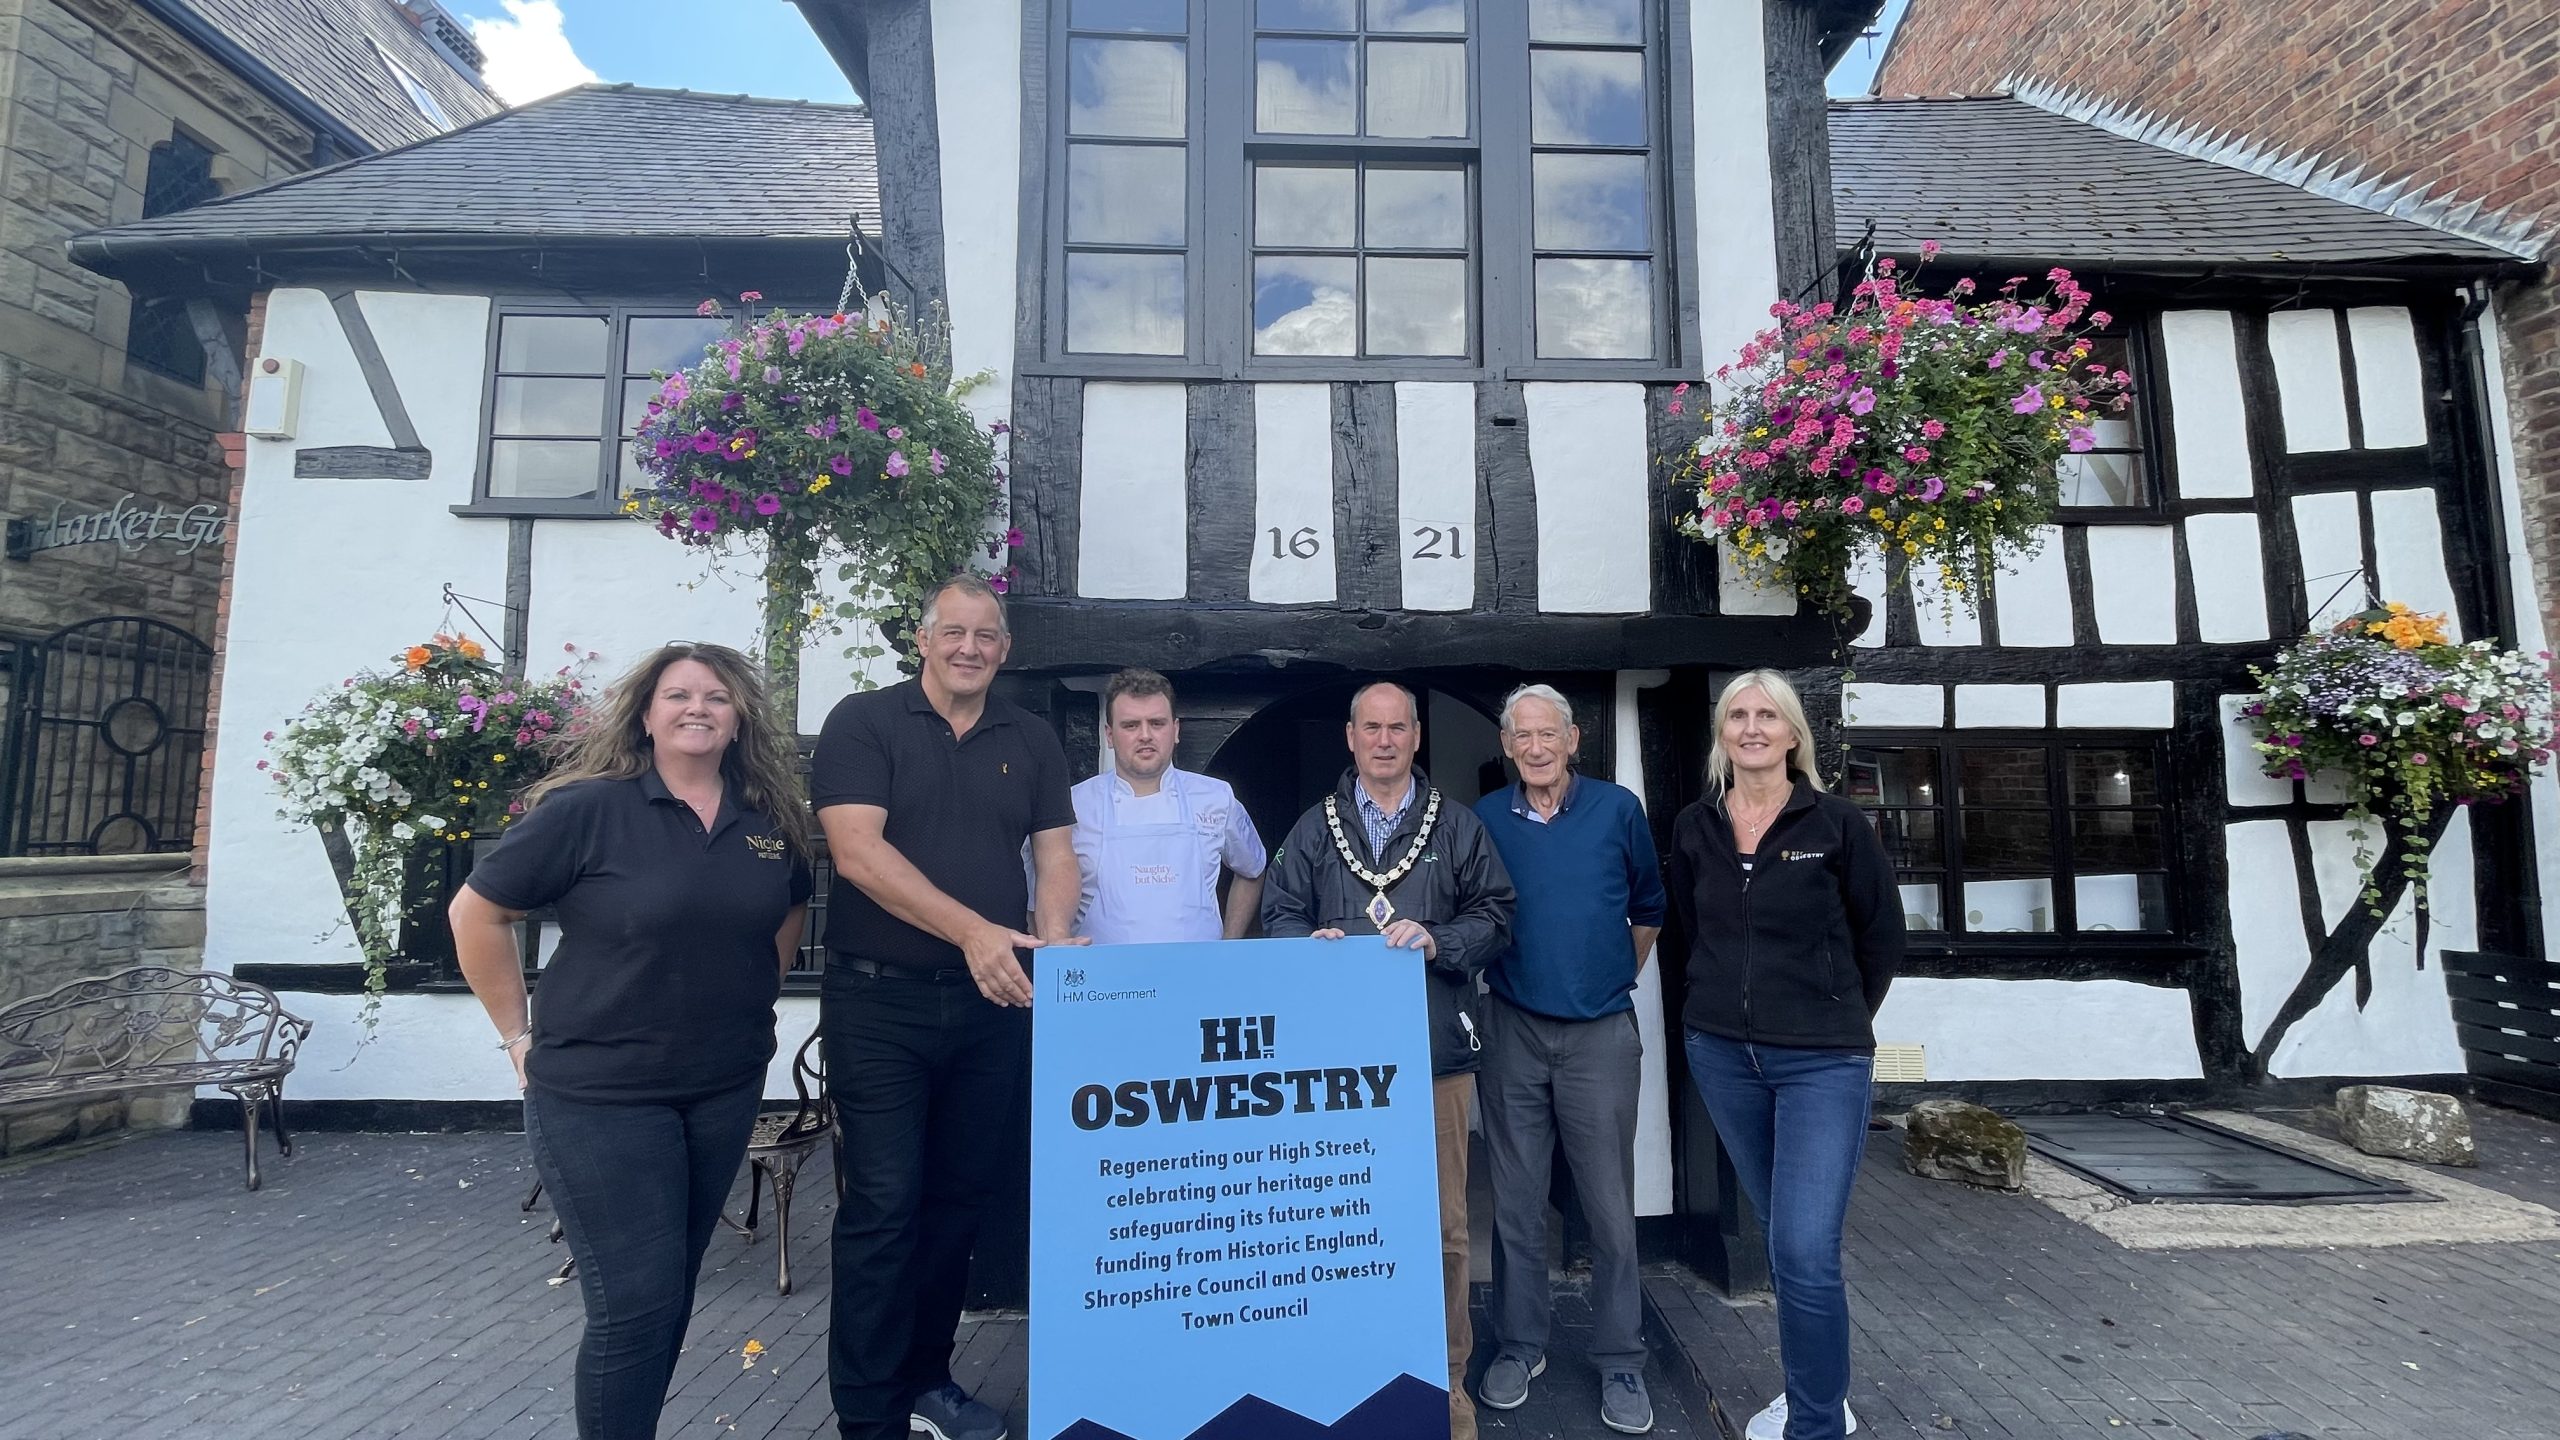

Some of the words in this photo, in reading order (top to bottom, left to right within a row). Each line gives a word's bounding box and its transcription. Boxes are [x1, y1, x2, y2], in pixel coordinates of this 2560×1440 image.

[1267, 526, 1320, 559] 16
[1412, 526, 1466, 559] 21
[745, 835, 785, 851] Niche
[1135, 876, 1150, 884] but
[1063, 991, 1084, 1002] HM
[1087, 988, 1157, 1001] Government
[1200, 1016, 1276, 1063] Hi!
[1071, 1065, 1398, 1131] OSWESTRY
[1100, 1149, 1228, 1179] Regenerating
[1232, 1150, 1264, 1165] our
[1269, 1141, 1310, 1164] High
[1315, 1138, 1377, 1158] Street,
[1106, 1181, 1216, 1209] celebrating
[1221, 1183, 1253, 1198] our
[1257, 1172, 1334, 1194] heritage
[1338, 1166, 1371, 1186] and
[1109, 1211, 1236, 1241] safeguarding
[1240, 1208, 1264, 1227] its
[1267, 1205, 1326, 1224] future
[1329, 1197, 1371, 1218] with
[1095, 1250, 1171, 1275] funding
[1176, 1246, 1222, 1266] from
[1228, 1235, 1301, 1261] Historic
[1305, 1227, 1384, 1255] England,
[1084, 1280, 1192, 1310] Shropshire
[1197, 1269, 1267, 1296] Council
[1271, 1265, 1306, 1288] and
[1311, 1260, 1396, 1284] Oswestry
[1181, 1311, 1234, 1331] Town
[1239, 1297, 1308, 1323] Council
